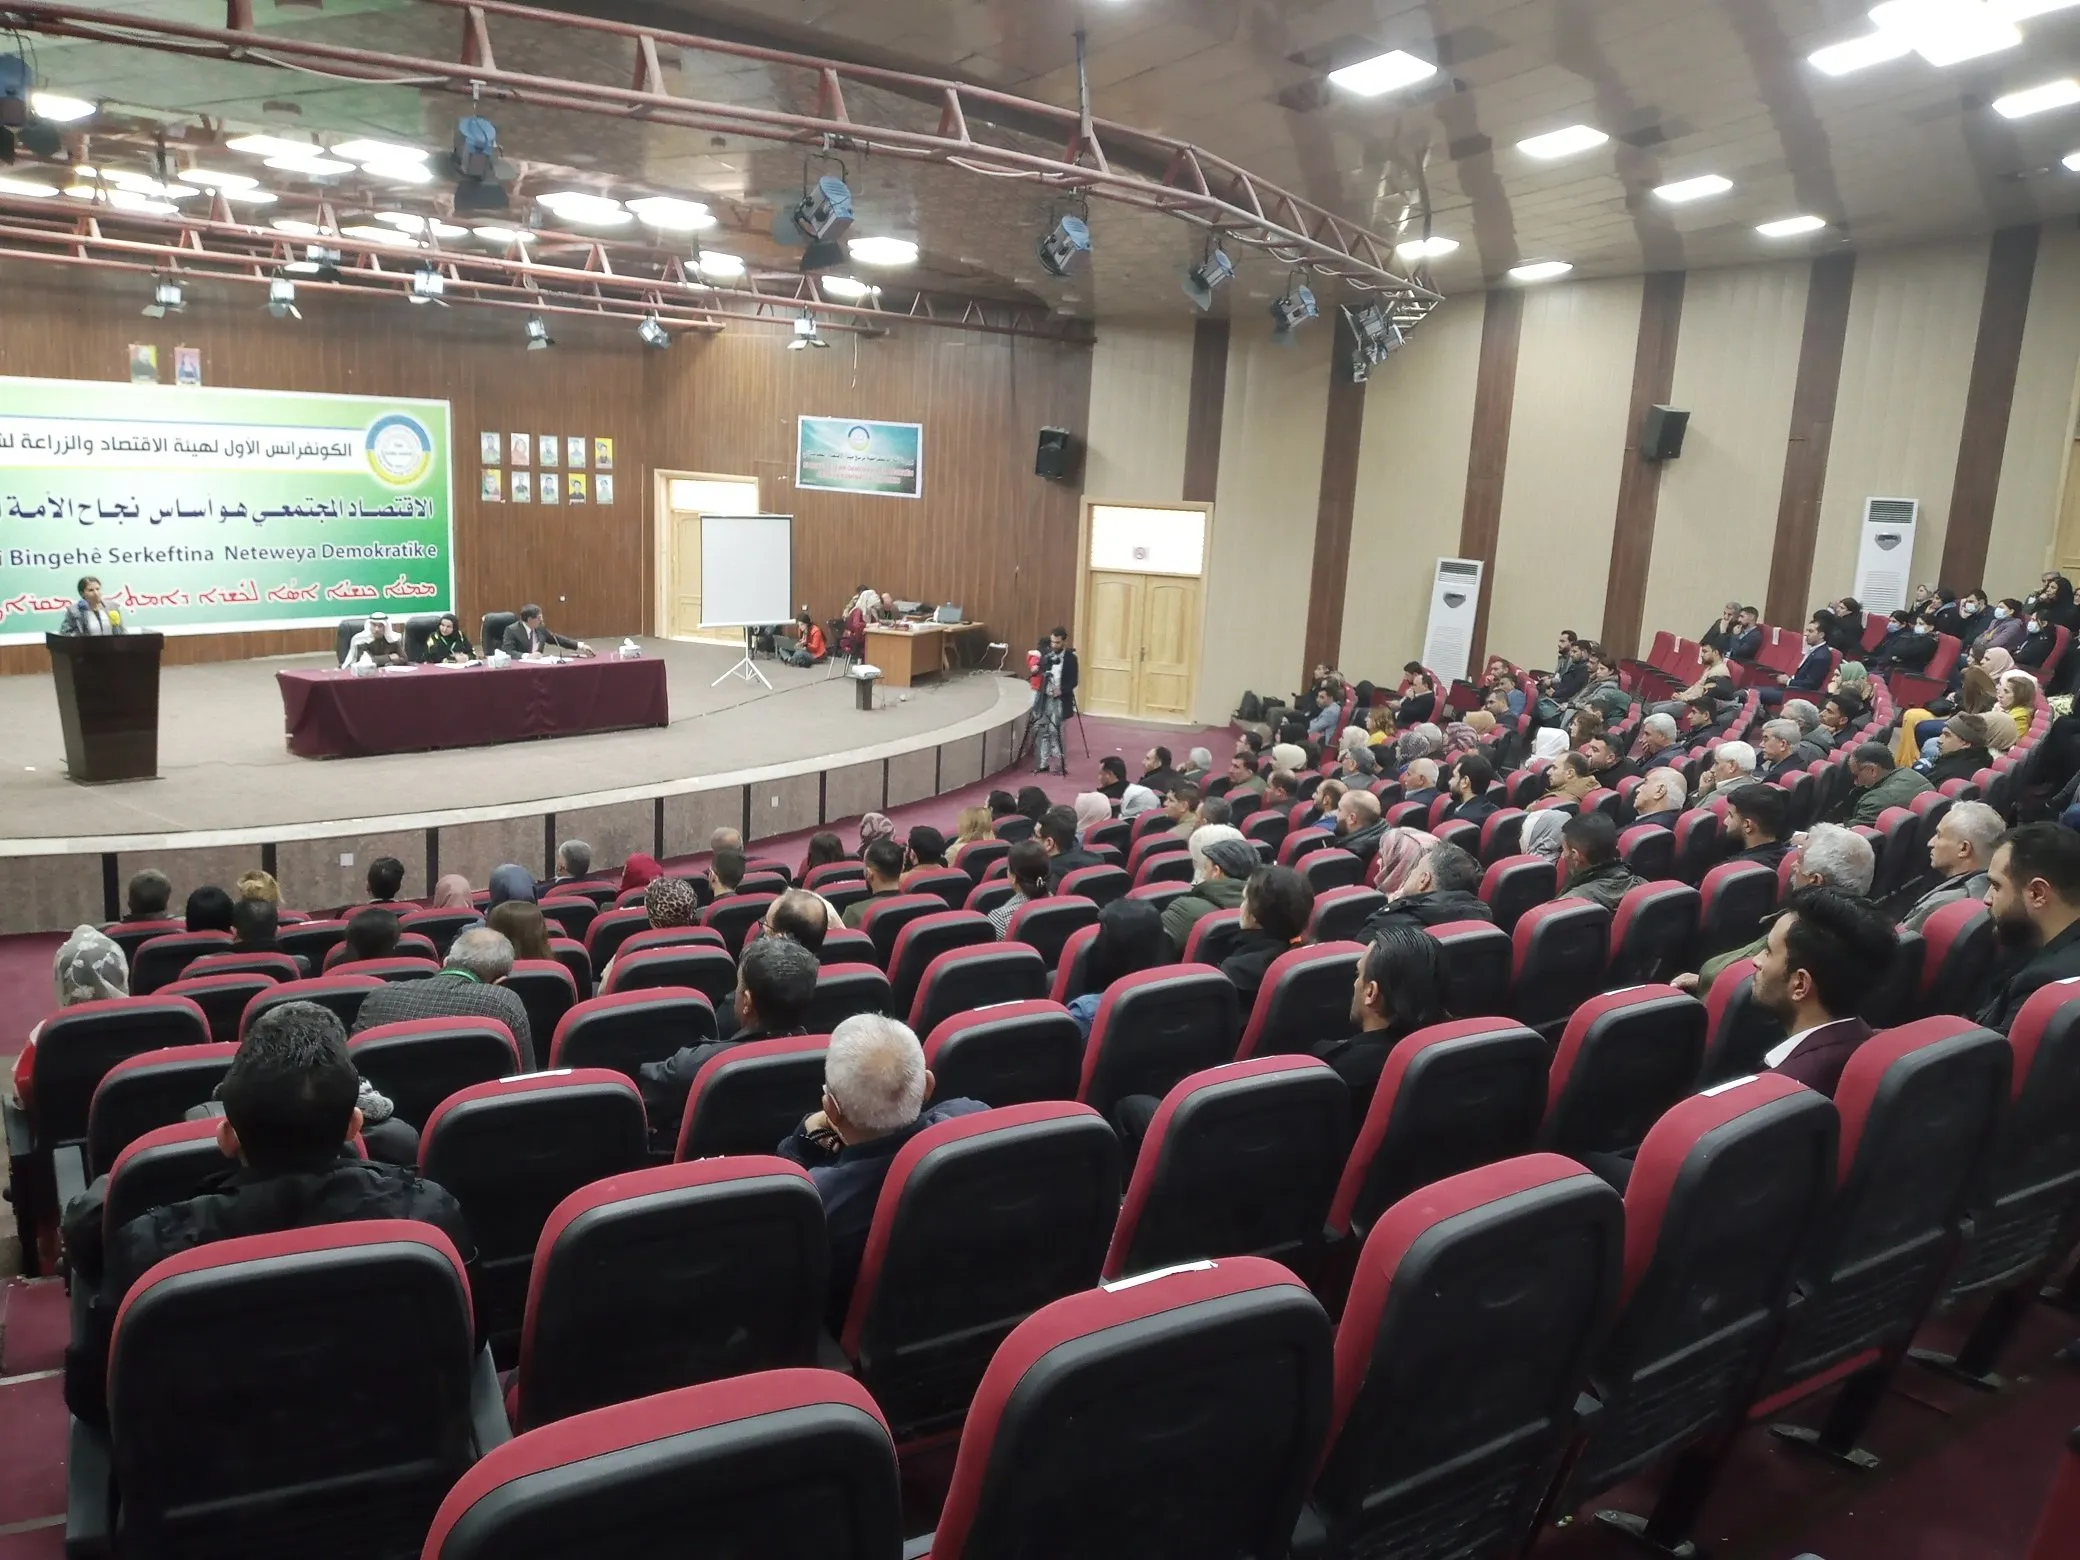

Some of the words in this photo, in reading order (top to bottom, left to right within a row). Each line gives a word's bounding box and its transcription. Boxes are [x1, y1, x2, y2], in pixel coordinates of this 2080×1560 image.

[21, 432, 94, 455] والزراعة
[101, 435, 168, 452] الاقتصاد
[174, 437, 219, 457] لهيئة
[265, 441, 352, 460] الكونفرانس
[78, 496, 140, 526] نجاح
[219, 501, 248, 523] هو
[252, 497, 344, 527] المجتمعي
[348, 496, 433, 517] الاقتصاد
[10, 547, 102, 570] Bingehê
[109, 545, 214, 564] Serkeftina
[225, 545, 316, 563] Neteweya
